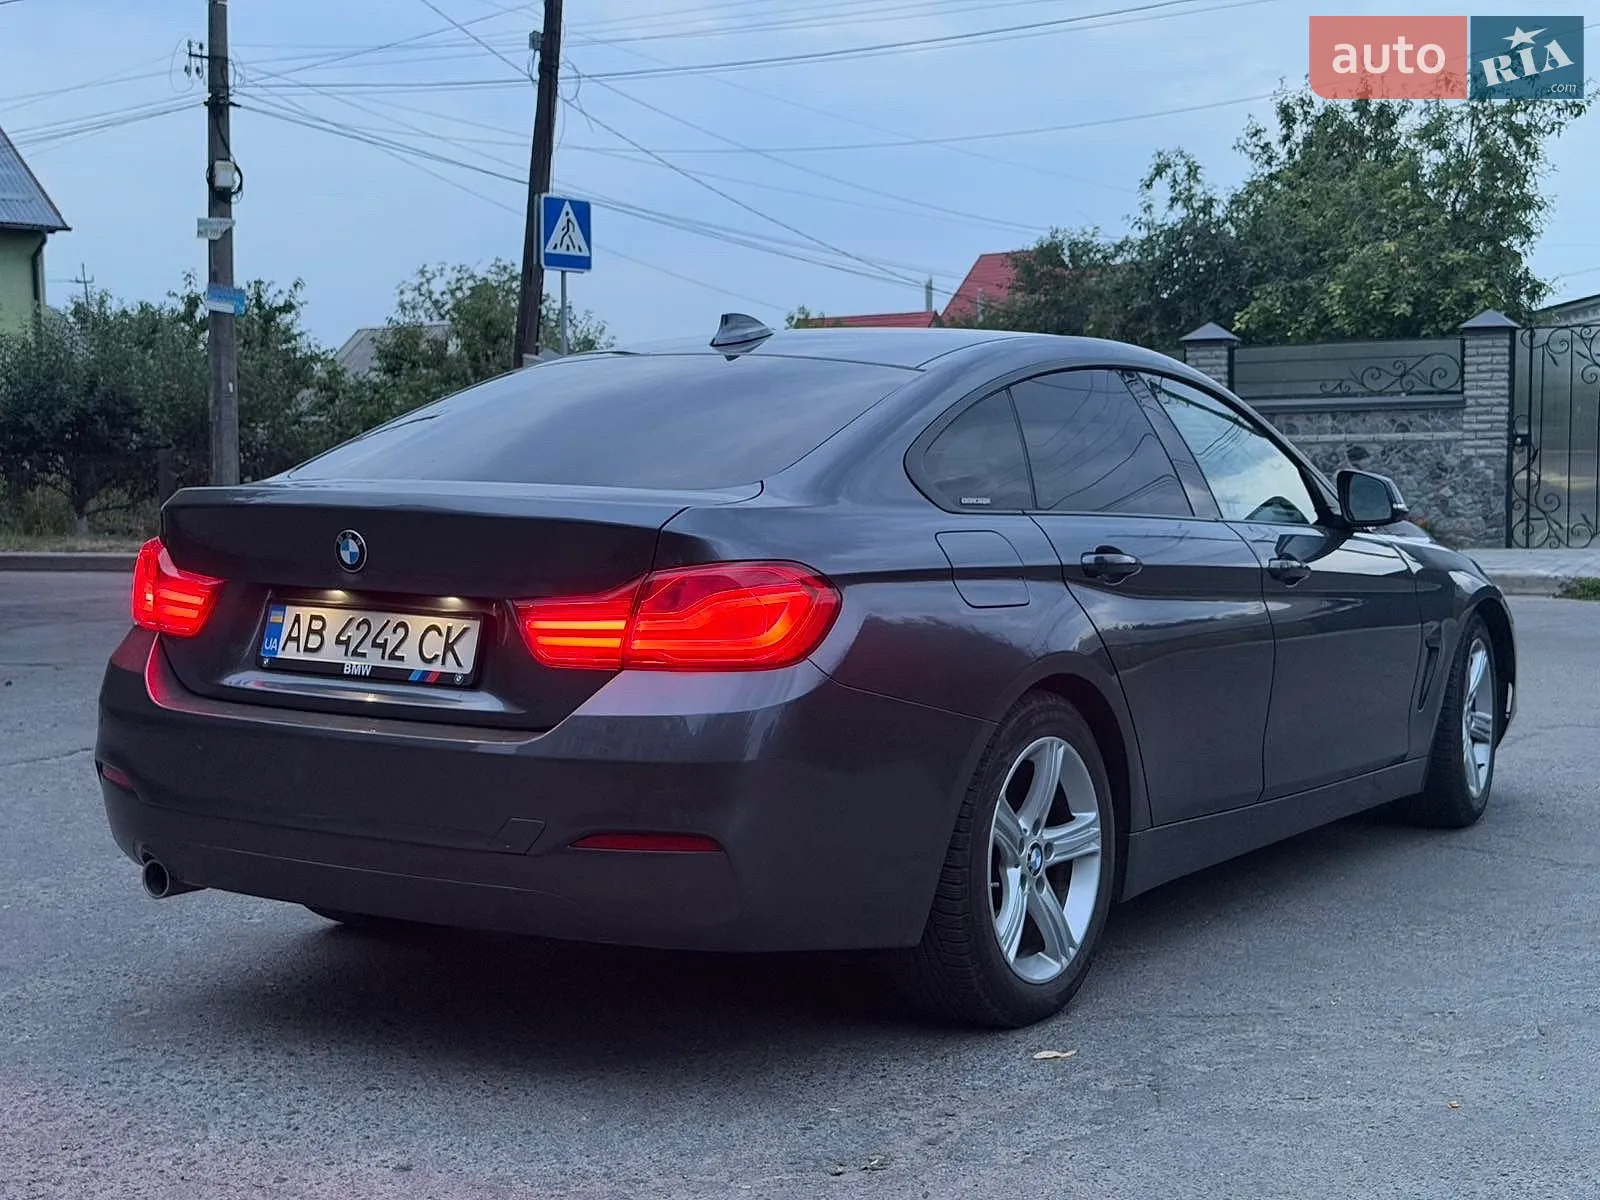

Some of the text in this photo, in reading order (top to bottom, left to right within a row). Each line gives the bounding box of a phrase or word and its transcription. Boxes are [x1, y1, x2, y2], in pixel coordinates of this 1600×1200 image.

[264, 637, 278, 650] UA
[282, 613, 470, 667] AB 4242 CK
[343, 663, 372, 677] BMW
